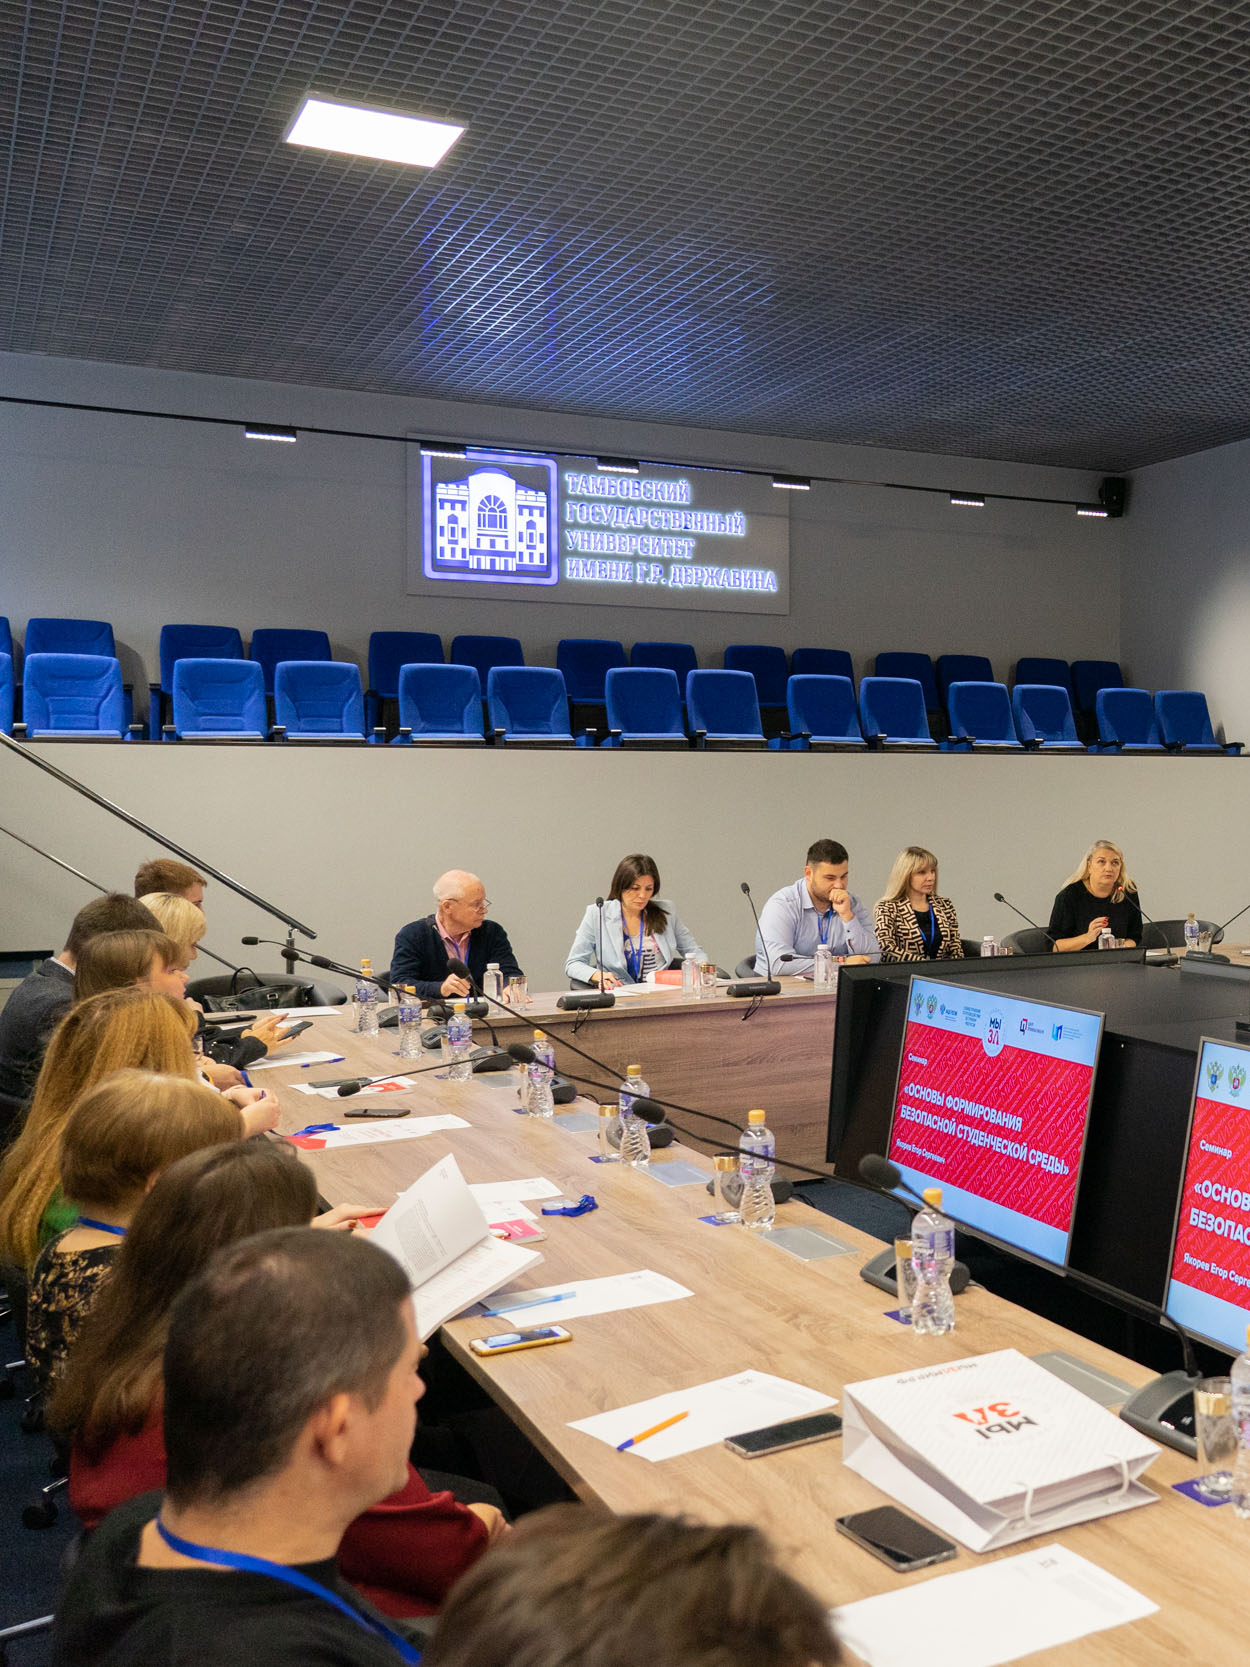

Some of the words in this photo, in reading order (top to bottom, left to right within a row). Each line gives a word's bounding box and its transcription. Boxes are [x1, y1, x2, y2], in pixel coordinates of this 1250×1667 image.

[565, 472, 690, 504] ТАМБОВСКИЙ
[566, 501, 746, 536] ГОСУДАРСТВЕННЫЙ
[566, 530, 695, 559] УНИВЕРСИТЕТ
[566, 558, 635, 583] ИМЕНИ
[670, 565, 777, 592] ДЕРЖАВИНА
[989, 1016, 1001, 1030] МЫ
[903, 1083, 945, 1105] «ОСНОВЫ
[944, 1095, 1023, 1131] ФОРМИРОВАНИЯ
[900, 1102, 957, 1134] БЕЗОПАСНОЙ
[955, 1121, 1029, 1161] СТУДЕНЧЕСКОЙ
[1027, 1150, 1071, 1176] СРЕДЫ»
[1199, 1140, 1233, 1159] Семинар
[1182, 1253, 1210, 1271] Якорев
[1209, 1264, 1229, 1279] Егор
[975, 1415, 1039, 1440] МЫ
